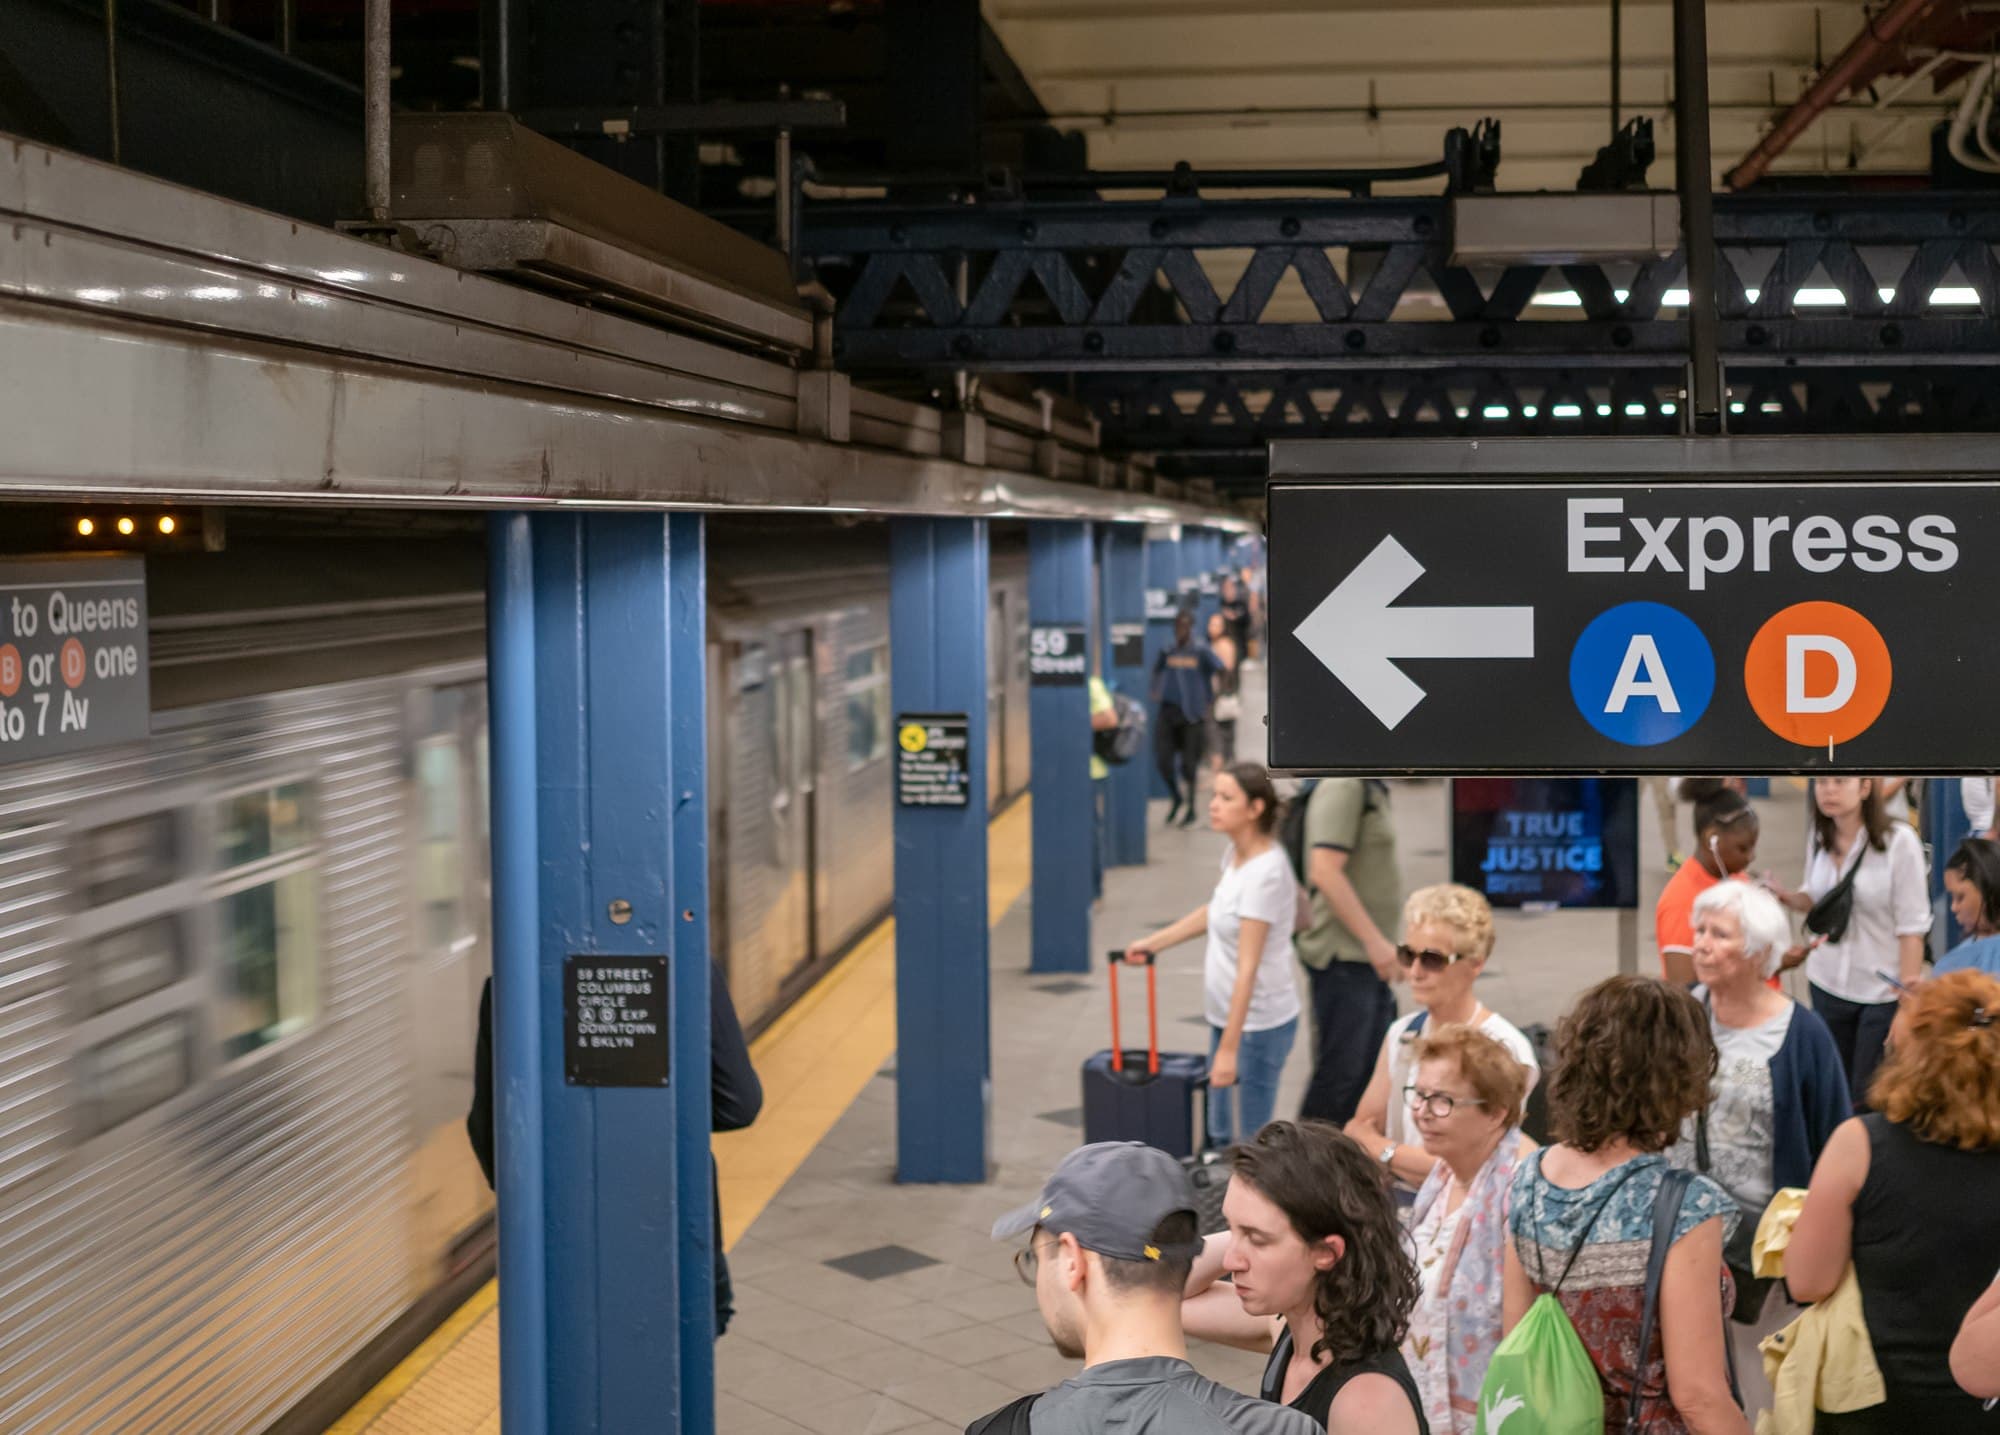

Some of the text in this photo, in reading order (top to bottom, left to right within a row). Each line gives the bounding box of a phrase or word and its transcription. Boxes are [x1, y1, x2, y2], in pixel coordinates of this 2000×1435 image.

[1567, 498, 1959, 590] Express
[11, 590, 138, 637] to Queens
[1031, 627, 1067, 656] 59
[2, 645, 137, 687] B or D one
[1030, 656, 1085, 673] Street
[1603, 634, 1857, 713] A D
[0, 689, 89, 742] to 7 Av
[1505, 811, 1584, 838] TRUE
[1480, 845, 1603, 872] JUSTICE
[577, 982, 652, 994] COLUMBUS
[577, 995, 627, 1008] CIRCLE
[577, 1022, 656, 1035] DOWNTOWN
[620, 1009, 648, 1021] EXP
[578, 1036, 634, 1048] & BKLYN
